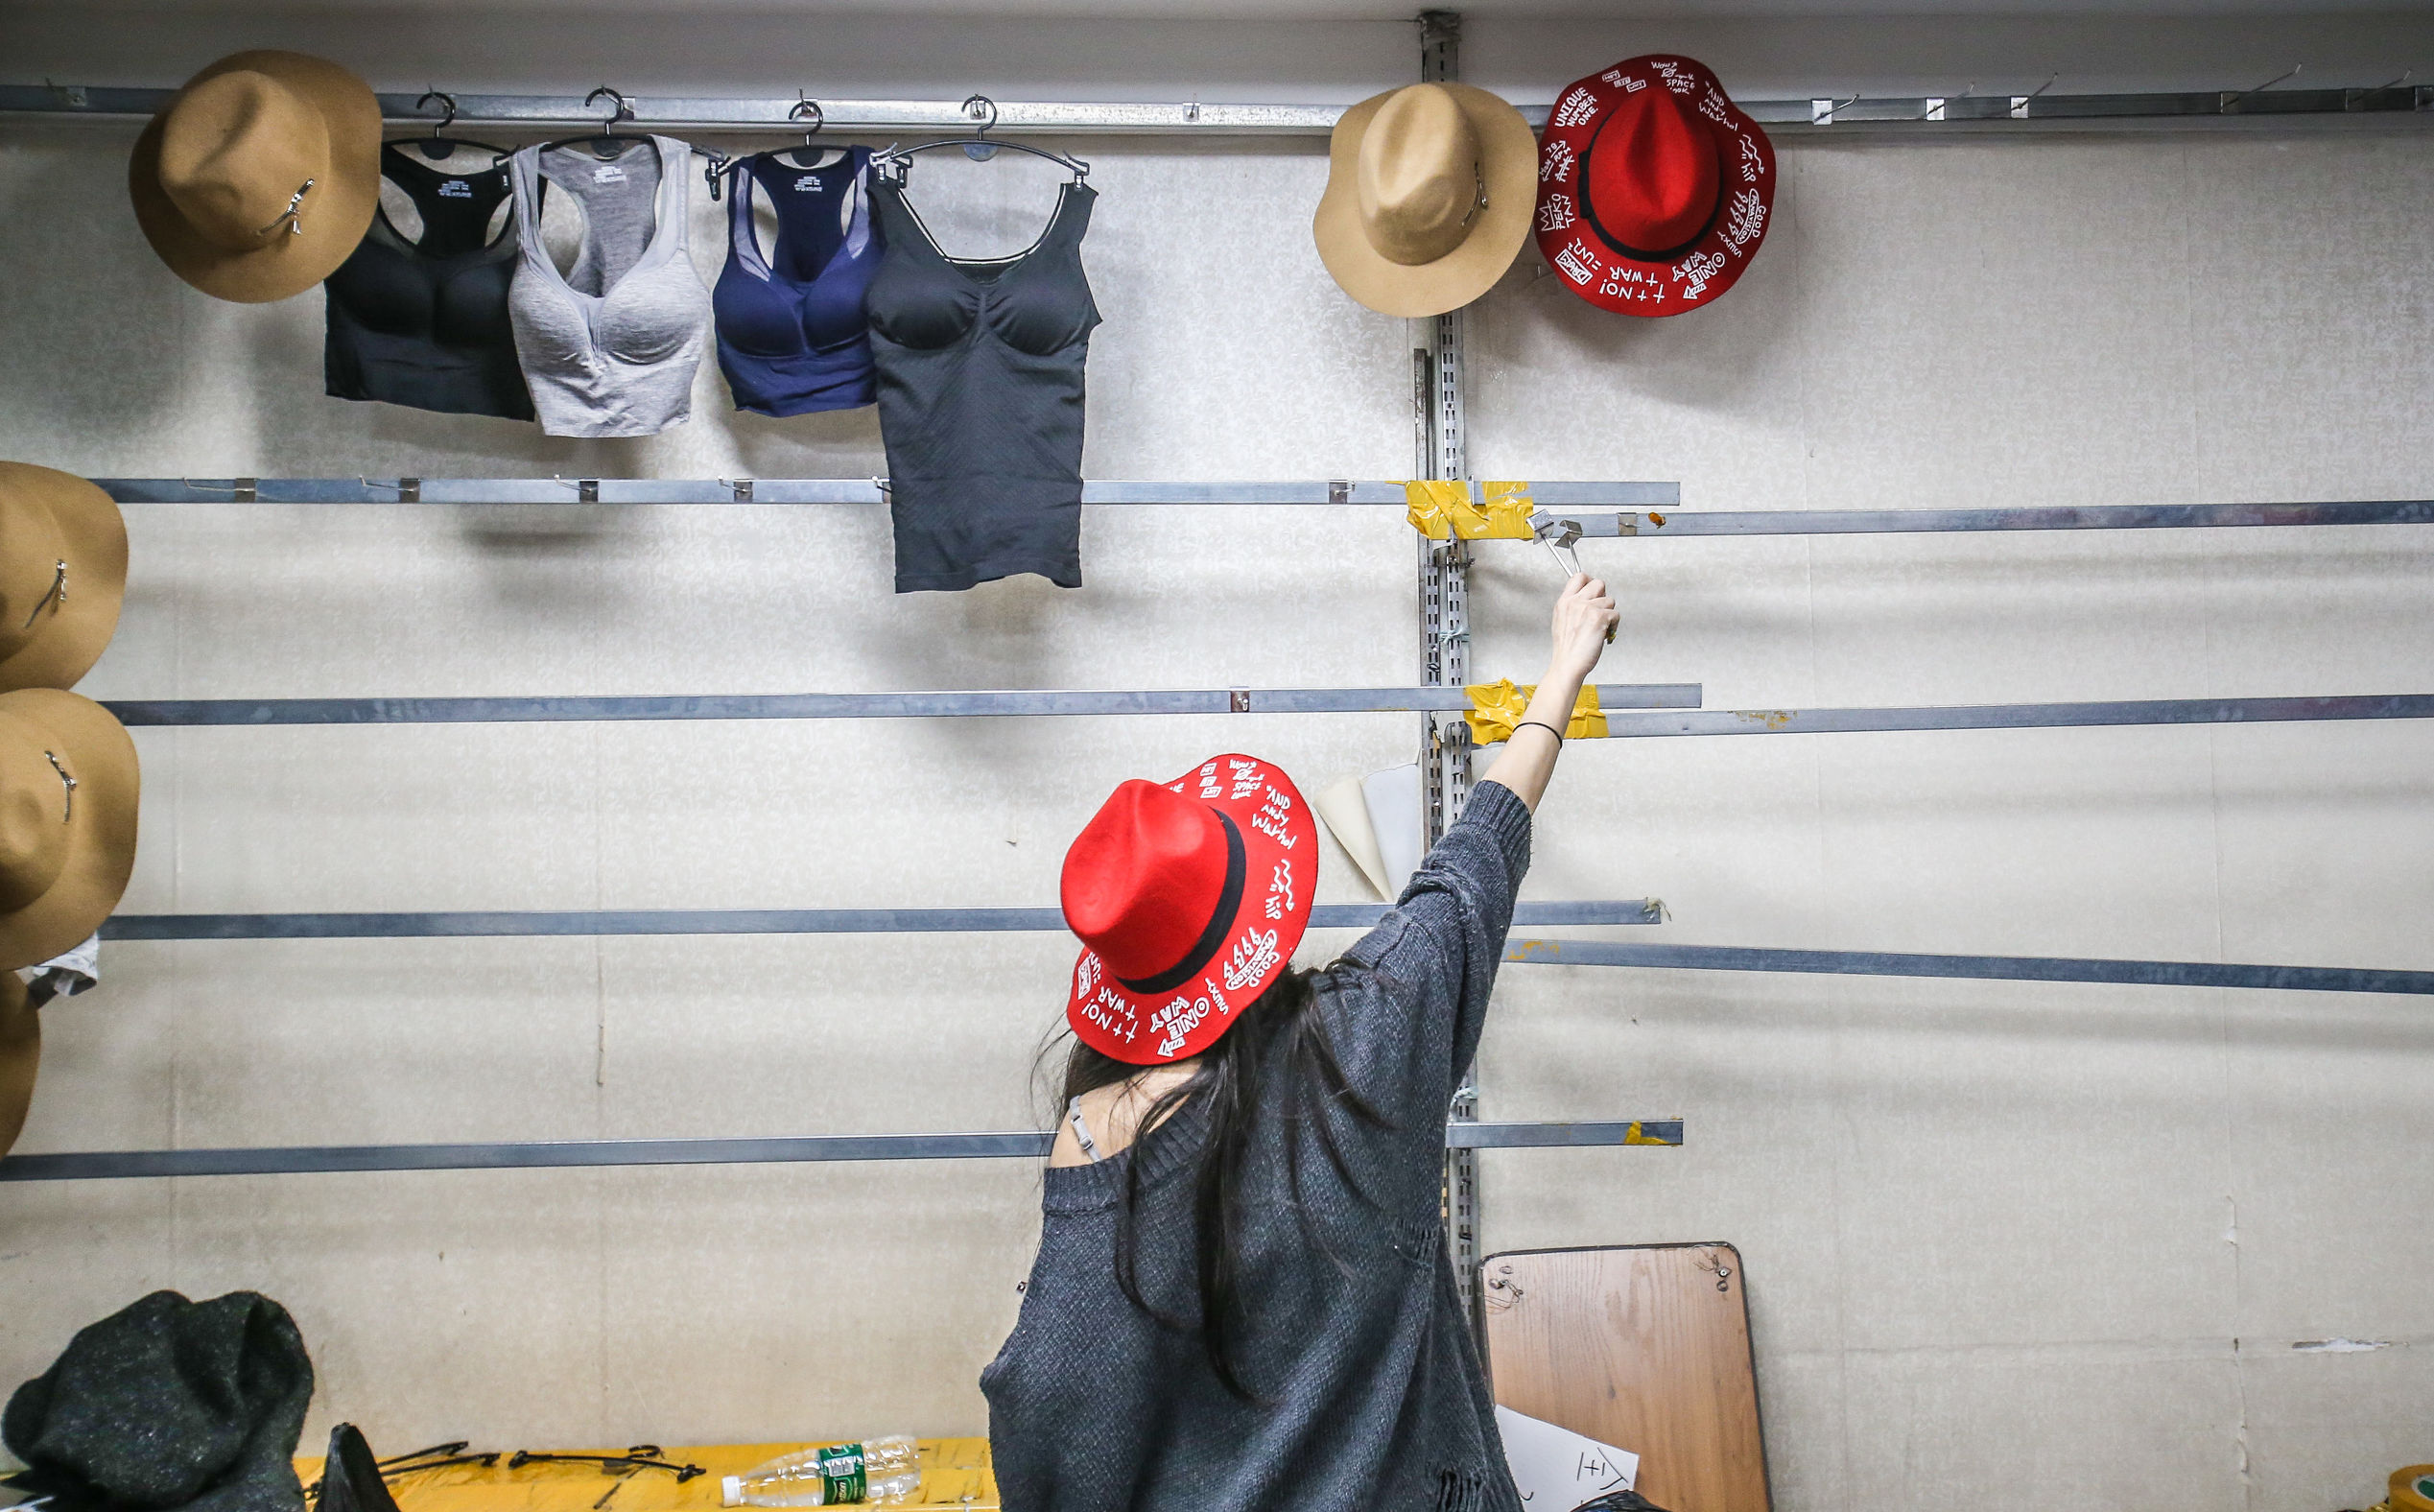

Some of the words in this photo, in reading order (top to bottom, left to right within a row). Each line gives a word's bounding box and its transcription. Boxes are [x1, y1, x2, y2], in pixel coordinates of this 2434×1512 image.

[1555, 87, 1588, 128] UNIQUE
[1567, 95, 1597, 127] NUMBER
[1551, 193, 1566, 230] PEKO
[1562, 195, 1575, 228] TAN
[1738, 195, 1758, 242] PANAVISION
[1752, 205, 1766, 238] GOOD
[1672, 251, 1707, 282] WAY
[1689, 252, 1725, 286] ONE
[1233, 782, 1261, 791] SPACE
[1230, 936, 1273, 988] PANAVISION
[1248, 952, 1281, 987] GOOD
[1150, 996, 1190, 1033] WAY
[1166, 997, 1210, 1040] ONE
